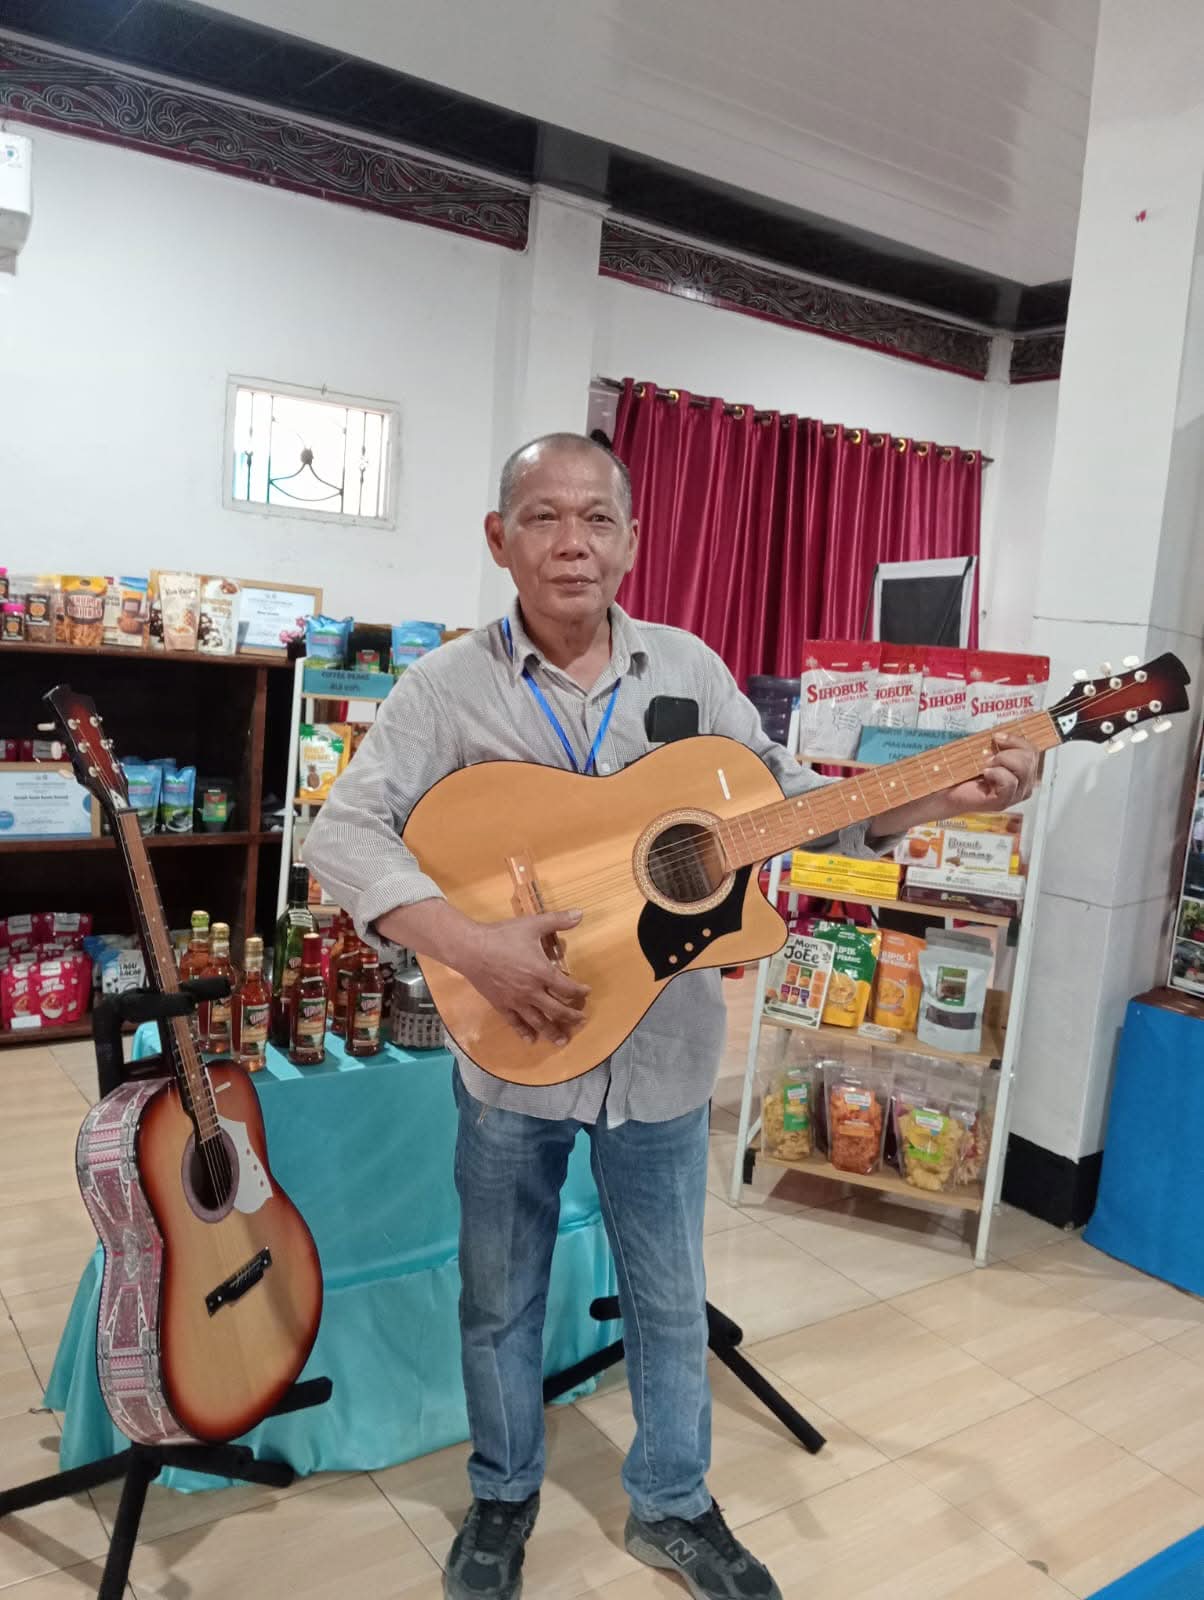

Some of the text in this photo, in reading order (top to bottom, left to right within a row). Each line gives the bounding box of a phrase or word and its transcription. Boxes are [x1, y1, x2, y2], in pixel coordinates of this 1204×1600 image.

[807, 681, 869, 703] SIHOBUK
[918, 691, 967, 712] SIHOB
[970, 696, 1035, 717] SIHOBUK
[794, 939, 819, 951] Mom
[665, 1537, 698, 1567] N
